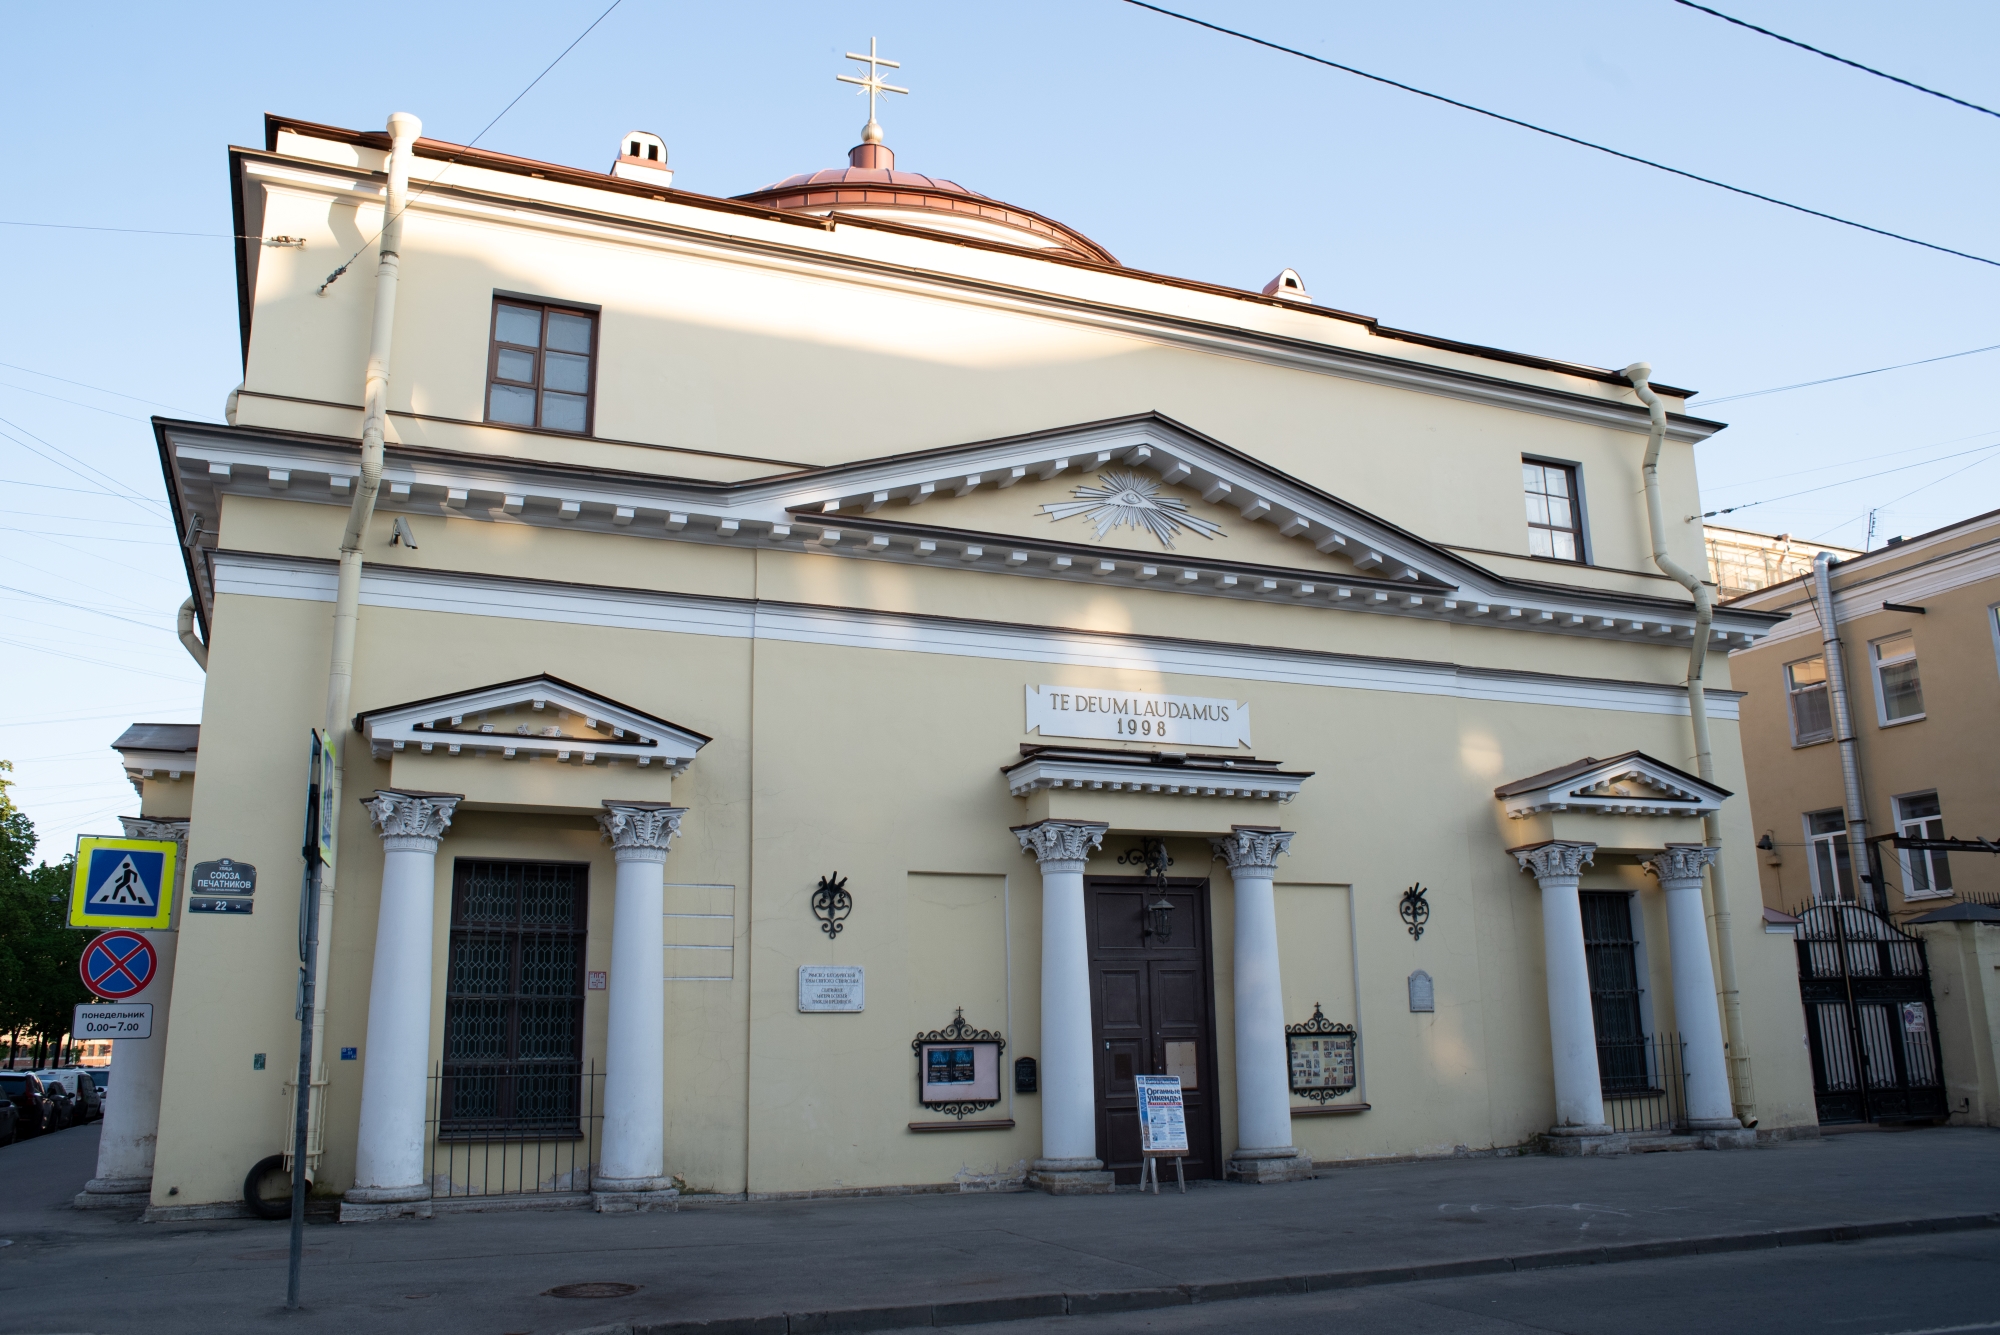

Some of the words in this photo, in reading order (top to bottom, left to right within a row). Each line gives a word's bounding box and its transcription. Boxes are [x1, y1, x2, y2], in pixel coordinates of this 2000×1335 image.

[1050, 693, 1069, 711] TE
[1075, 695, 1128, 715] DEUM
[1133, 699, 1229, 722] LAUDAMUS
[1117, 718, 1166, 736] 1998
[210, 871, 240, 880] СОЮЗА
[197, 880, 251, 888] ПЕЧАТНИКОВ
[215, 901, 227, 910] 22
[81, 1011, 145, 1019] понедельник
[1146, 1088, 1180, 1096] Органные
[1147, 1095, 1181, 1104] уикенды
